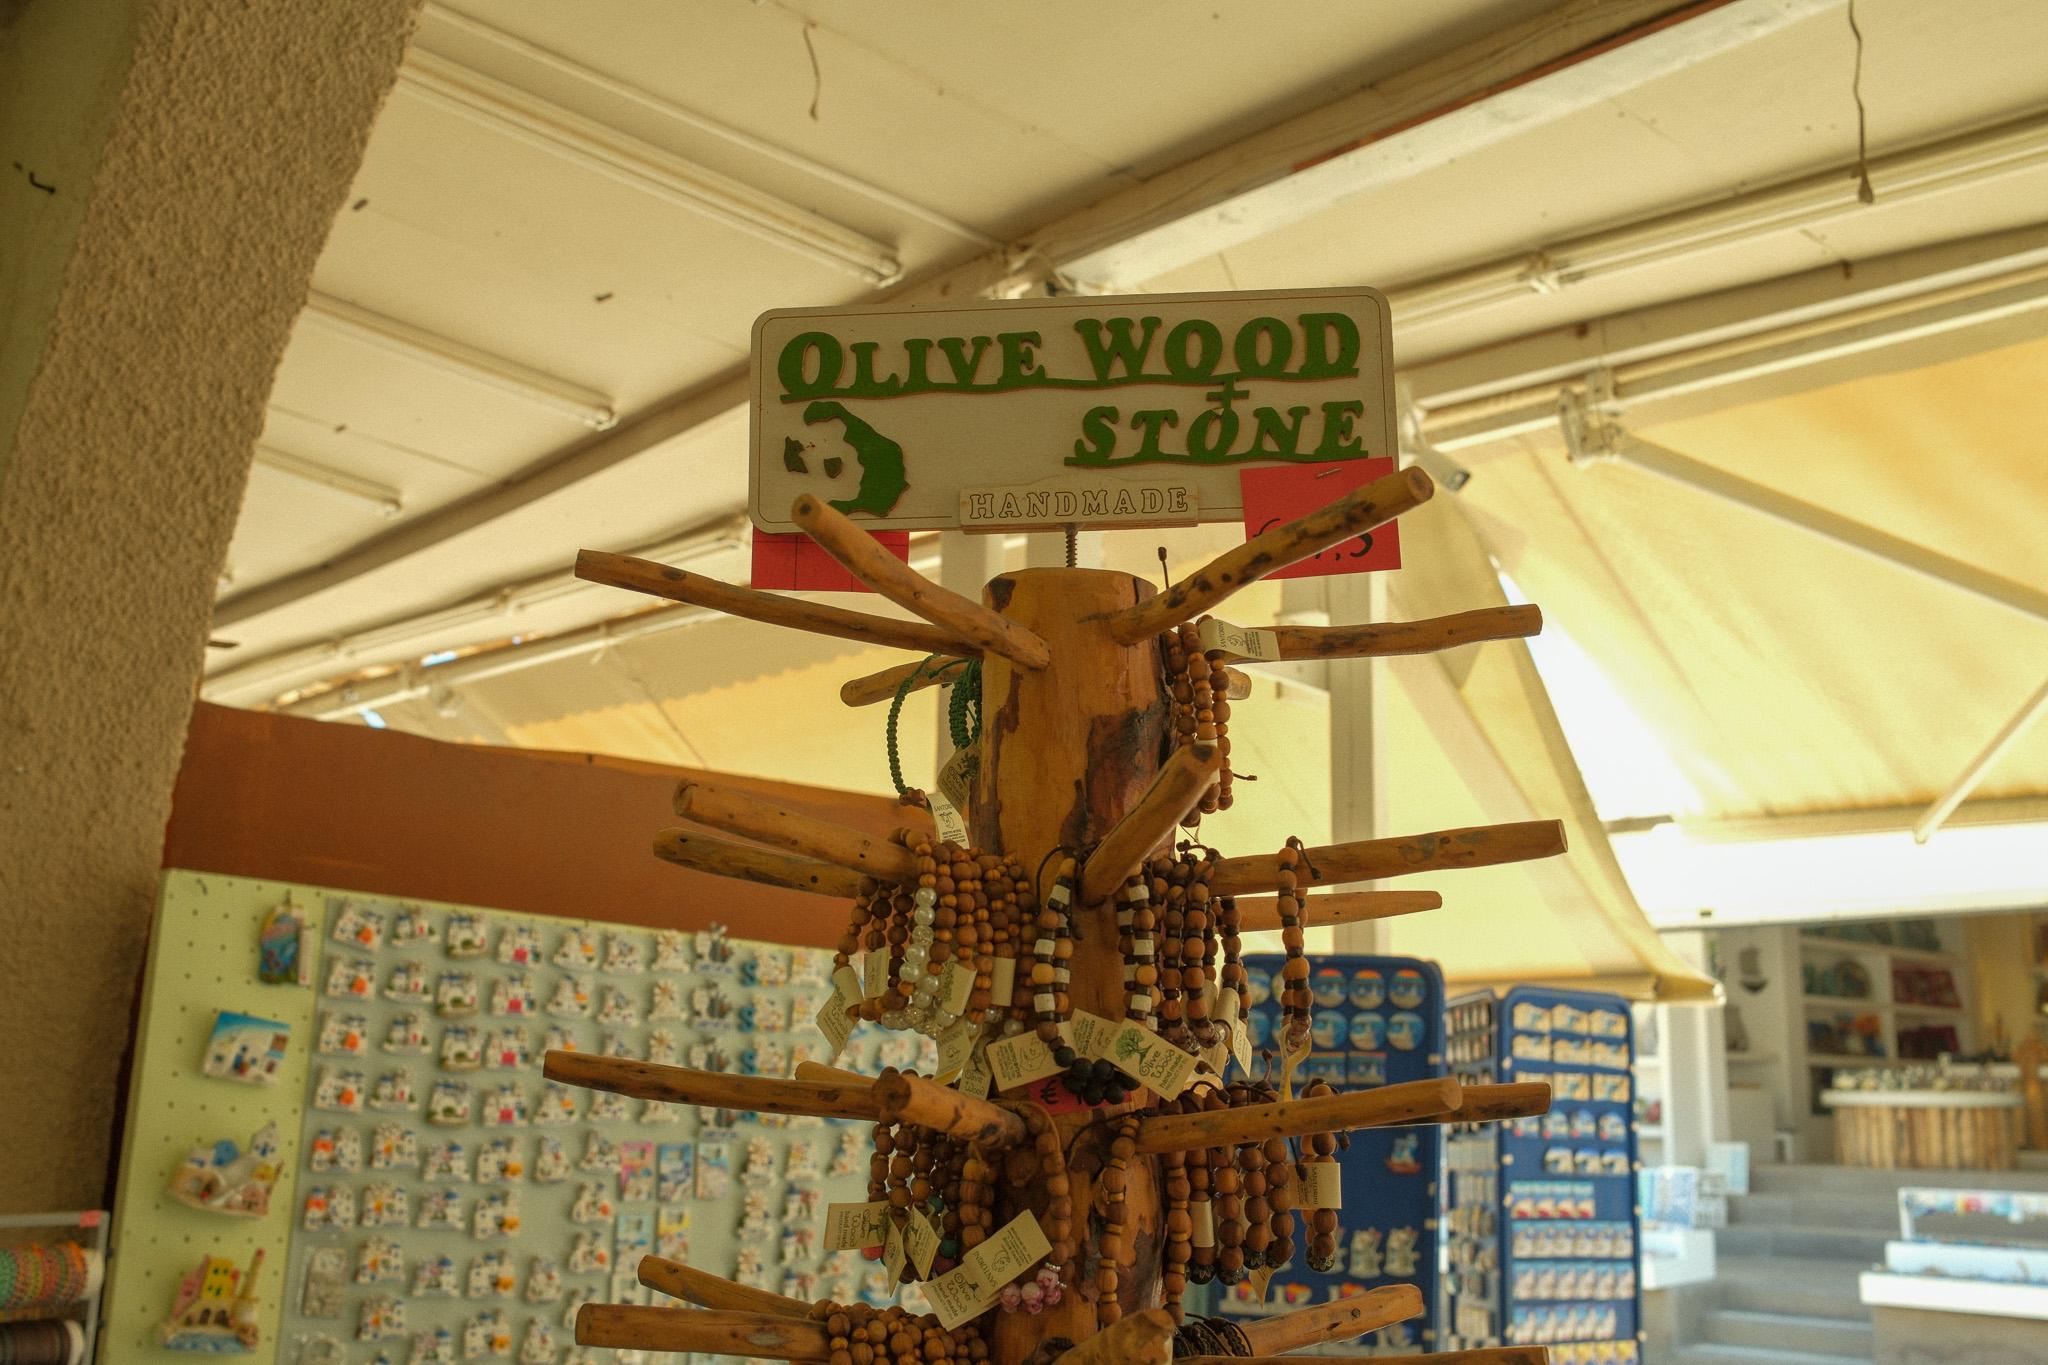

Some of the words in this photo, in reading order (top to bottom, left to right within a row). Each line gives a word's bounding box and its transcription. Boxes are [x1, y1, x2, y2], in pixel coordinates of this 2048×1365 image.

[778, 331, 1046, 404] OLIVE
[1073, 312, 1361, 388] WOOD
[1064, 399, 1369, 467] STONE
[969, 486, 1188, 520] HANDMADE
[1139, 1050, 1161, 1077] Olive
[1151, 1047, 1176, 1079] Wood
[843, 1210, 851, 1228] hand
[848, 1212, 861, 1247] Wood
[860, 1208, 871, 1239] Olive
[840, 1228, 849, 1248] made
[973, 1251, 998, 1288] SANTORINI
[937, 1281, 949, 1299] hand
[946, 1298, 959, 1318] made
[946, 1280, 968, 1313] Wood
[954, 1273, 971, 1301] Olive
